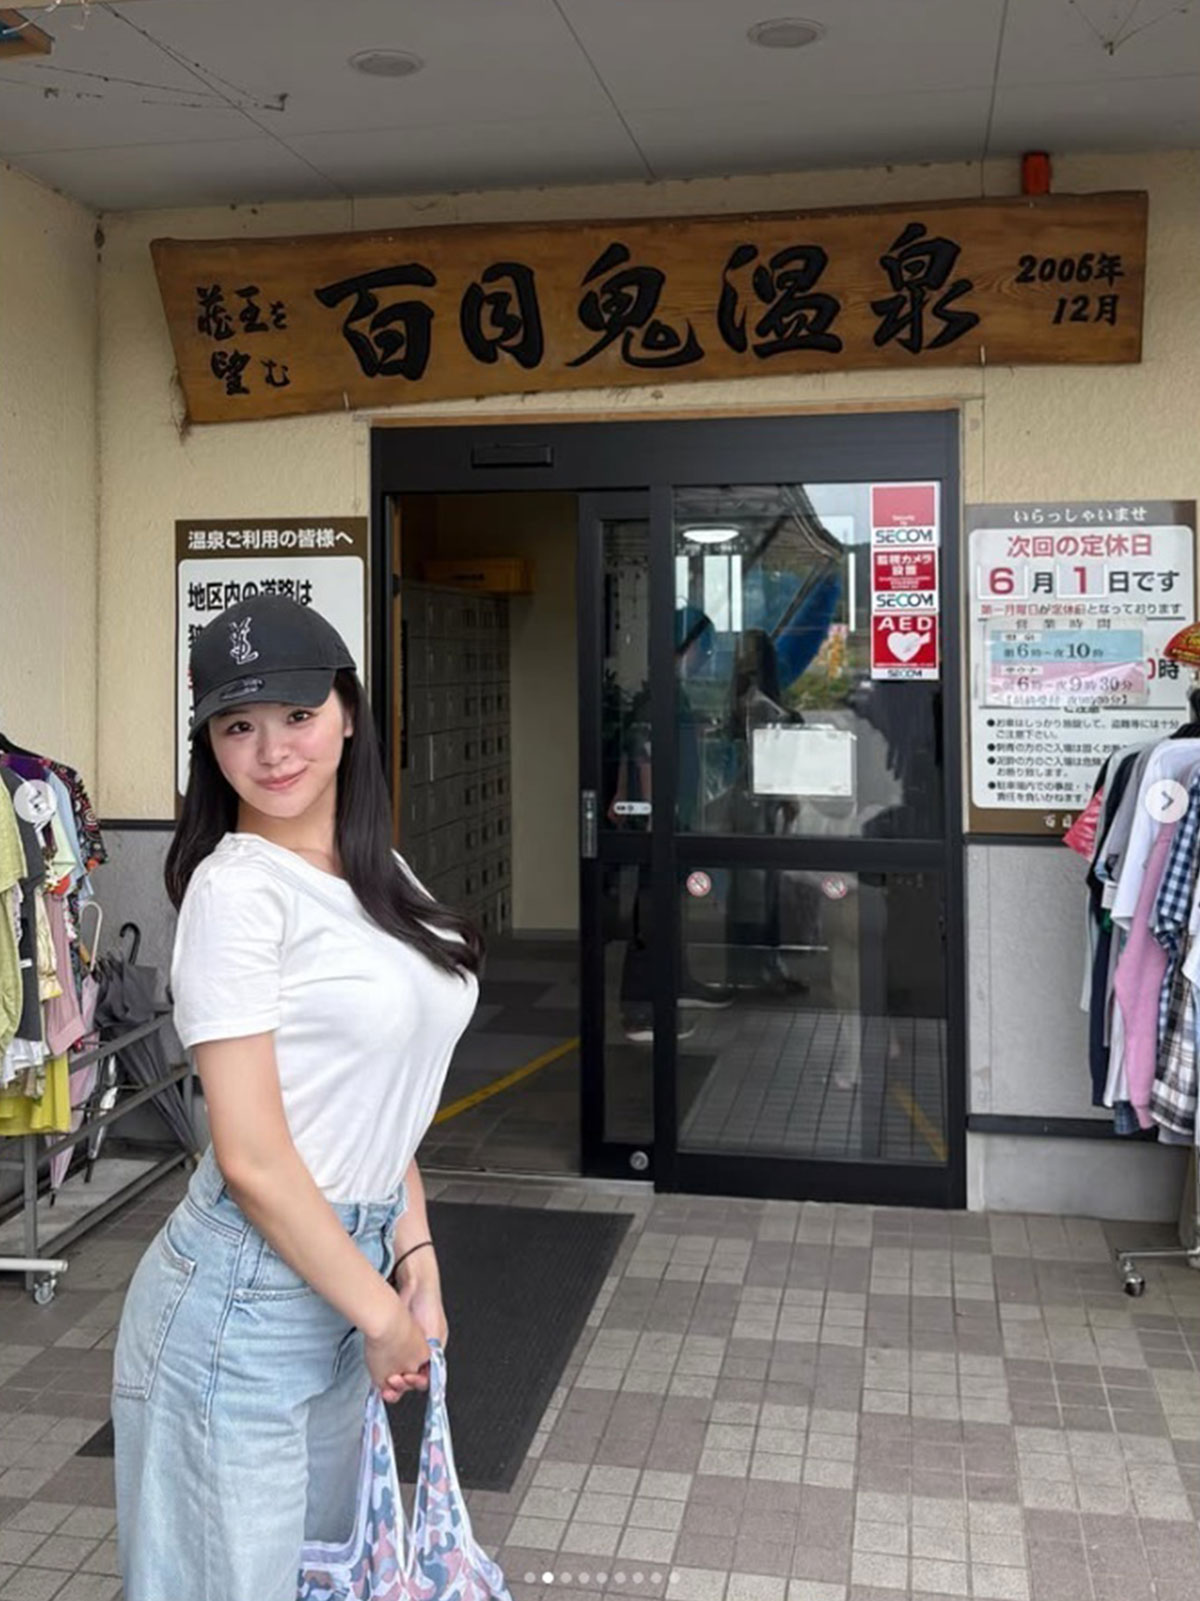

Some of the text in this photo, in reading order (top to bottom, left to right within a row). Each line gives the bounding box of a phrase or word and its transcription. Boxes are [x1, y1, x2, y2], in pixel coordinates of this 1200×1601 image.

[1015, 253, 1125, 284] 2006年
[314, 222, 980, 381] 百目鬼温泉
[1053, 294, 1119, 326] 12月
[1014, 507, 1147, 523] いらっしゃいませ
[188, 529, 353, 549] 温泉ご利用の皆様へ
[875, 529, 933, 543] SECOM
[1006, 534, 1151, 559] 次回の定休日
[876, 593, 934, 607] SECOM
[877, 617, 933, 631] AED
[888, 669, 923, 678] SECOM
